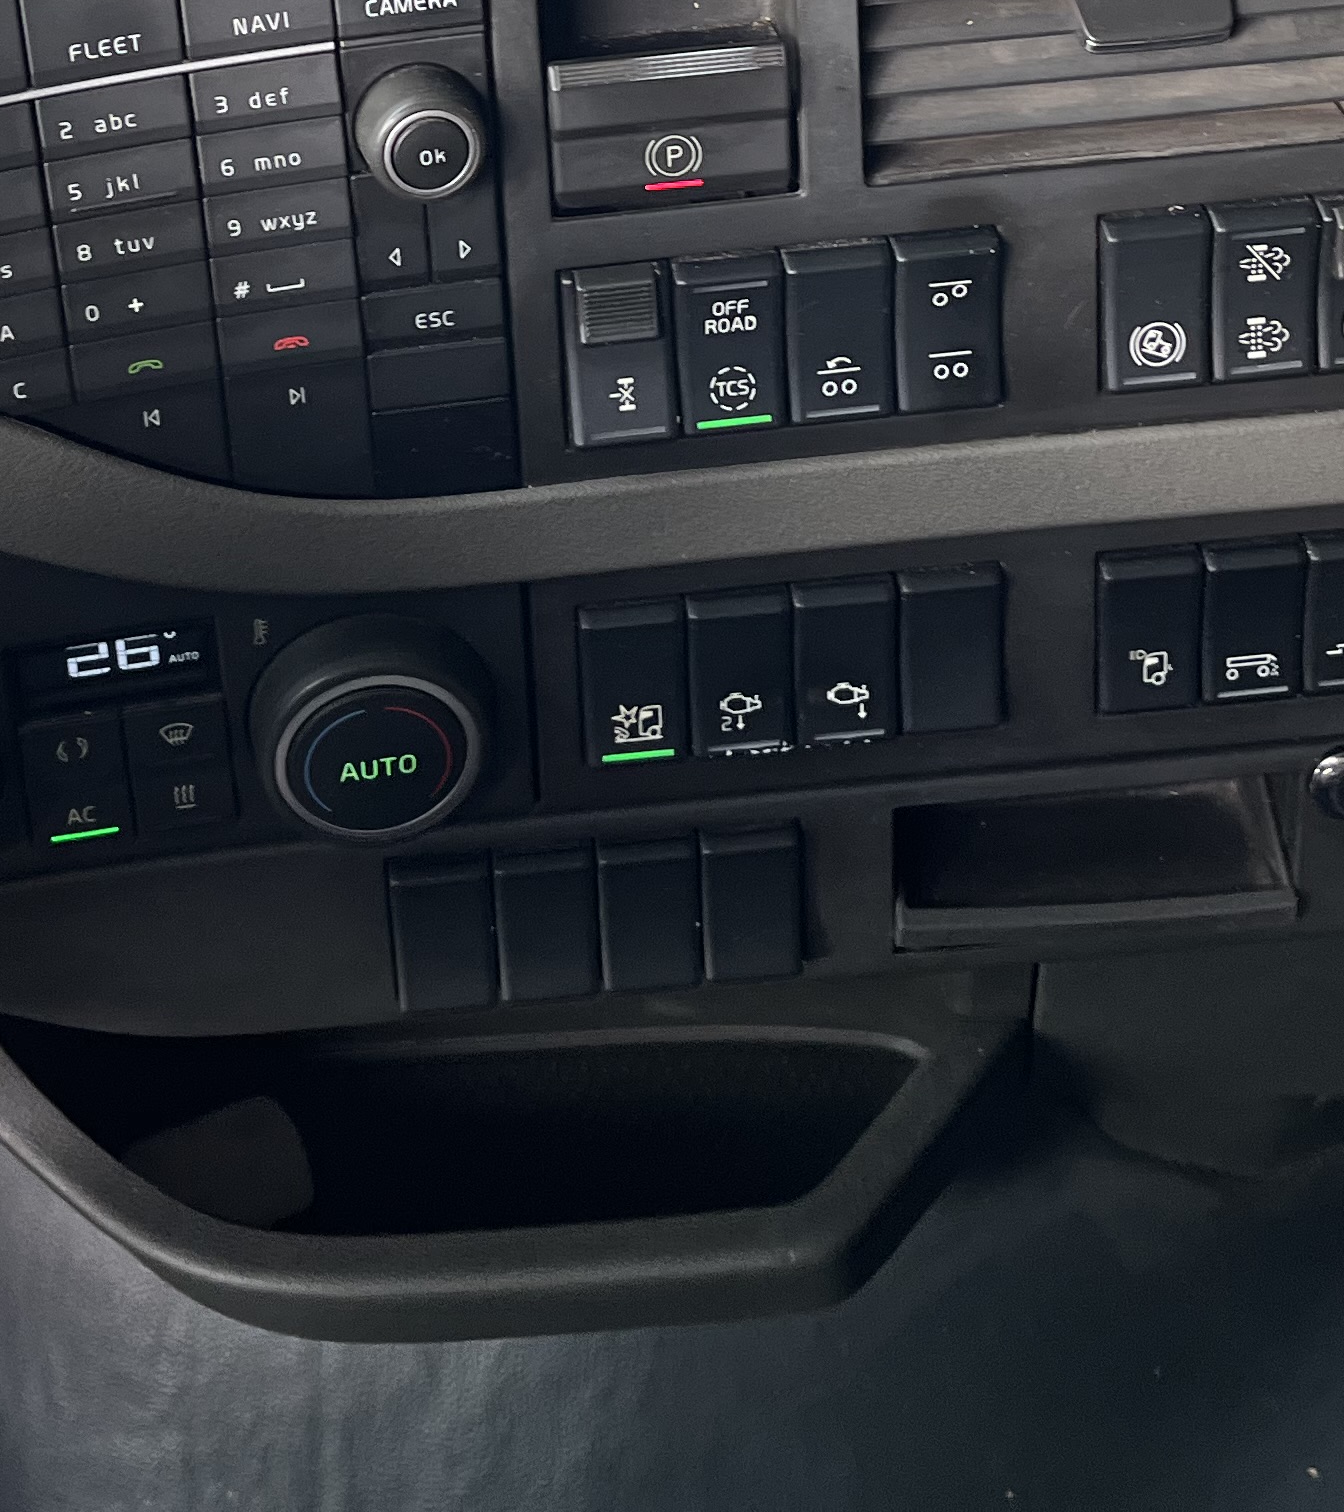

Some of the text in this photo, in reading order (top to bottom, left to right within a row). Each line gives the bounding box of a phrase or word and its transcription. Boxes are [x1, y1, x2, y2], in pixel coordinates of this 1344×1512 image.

[232, 11, 290, 36] NAVI
[68, 33, 142, 62] FLEET
[213, 87, 289, 114] 3 def
[58, 113, 138, 140] 2 abc
[220, 152, 302, 177] 6 mno
[419, 148, 447, 166] Ok
[67, 173, 140, 201] 5 jkl
[227, 211, 318, 237] 9 wxyz
[76, 236, 155, 262] 8 tuv
[84, 304, 100, 322] 0
[712, 299, 749, 317] OFF
[414, 310, 455, 329] ESC
[704, 315, 757, 335] ROAD
[12, 382, 27, 399] C
[716, 379, 749, 398] TCS
[168, 651, 200, 664] AUTO
[721, 715, 733, 732] 2
[340, 754, 417, 783] AUTO
[67, 805, 97, 826] AC
